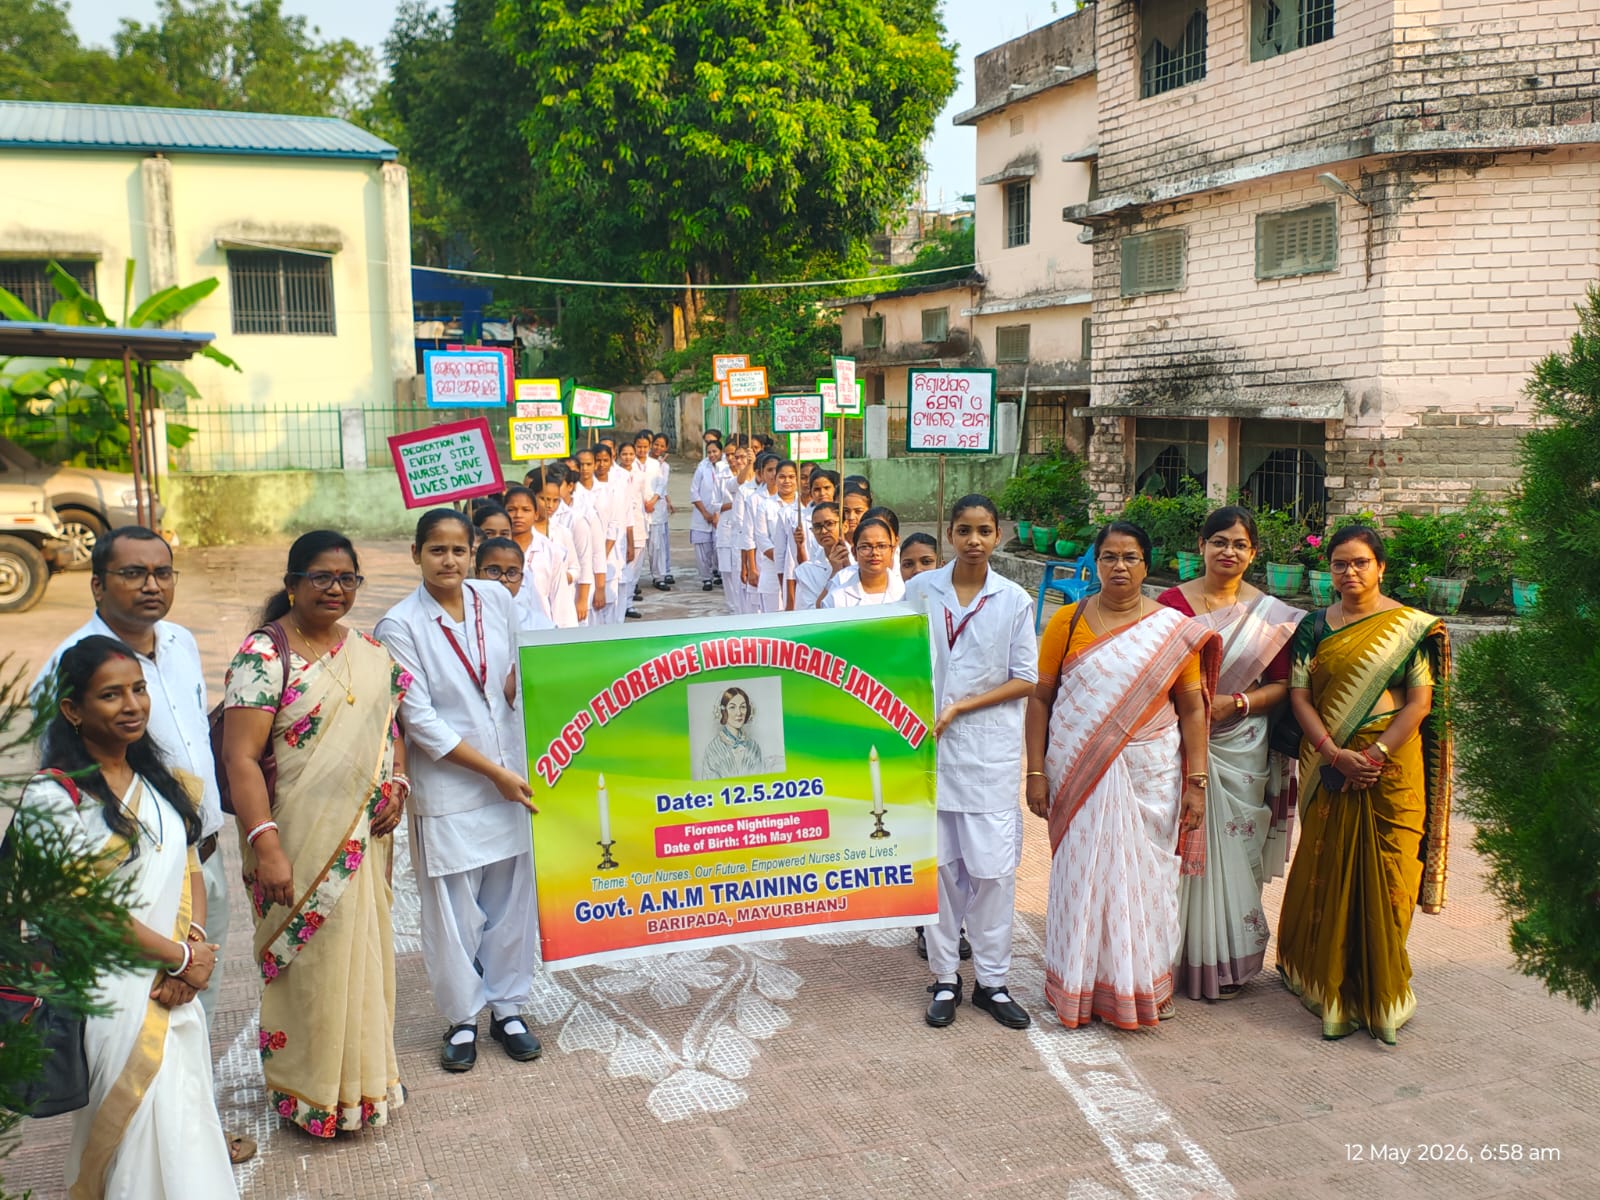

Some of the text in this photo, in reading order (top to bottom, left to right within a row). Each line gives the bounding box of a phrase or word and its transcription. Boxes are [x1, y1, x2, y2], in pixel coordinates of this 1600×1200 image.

[926, 395, 983, 410] ସେବା ଓ
[962, 412, 989, 427] ଅନ୍ୟ
[401, 434, 470, 456] DEDICATION IN
[922, 434, 946, 446] ନାମ
[408, 457, 483, 481] NURSES SAVE
[409, 446, 475, 468] EVERY STEP
[413, 470, 483, 496] LIVES DAILY
[537, 637, 928, 786] 206th FLORENCE NIGHTINGALE JAYANTI
[656, 778, 824, 813] Date: 12.5.2026
[685, 815, 800, 837] Florence Nightingale
[664, 827, 822, 854] Date of Birth: 12th May 1820
[592, 877, 628, 891] Theme:
[695, 866, 712, 878] Our
[751, 854, 806, 873] Empowered
[808, 851, 841, 862] Nurses
[844, 848, 866, 860] Save
[575, 864, 913, 922] Govt. A.N.M TRAINING CENTRE
[647, 898, 847, 933] BARIPADA, MAYURBHANJ
